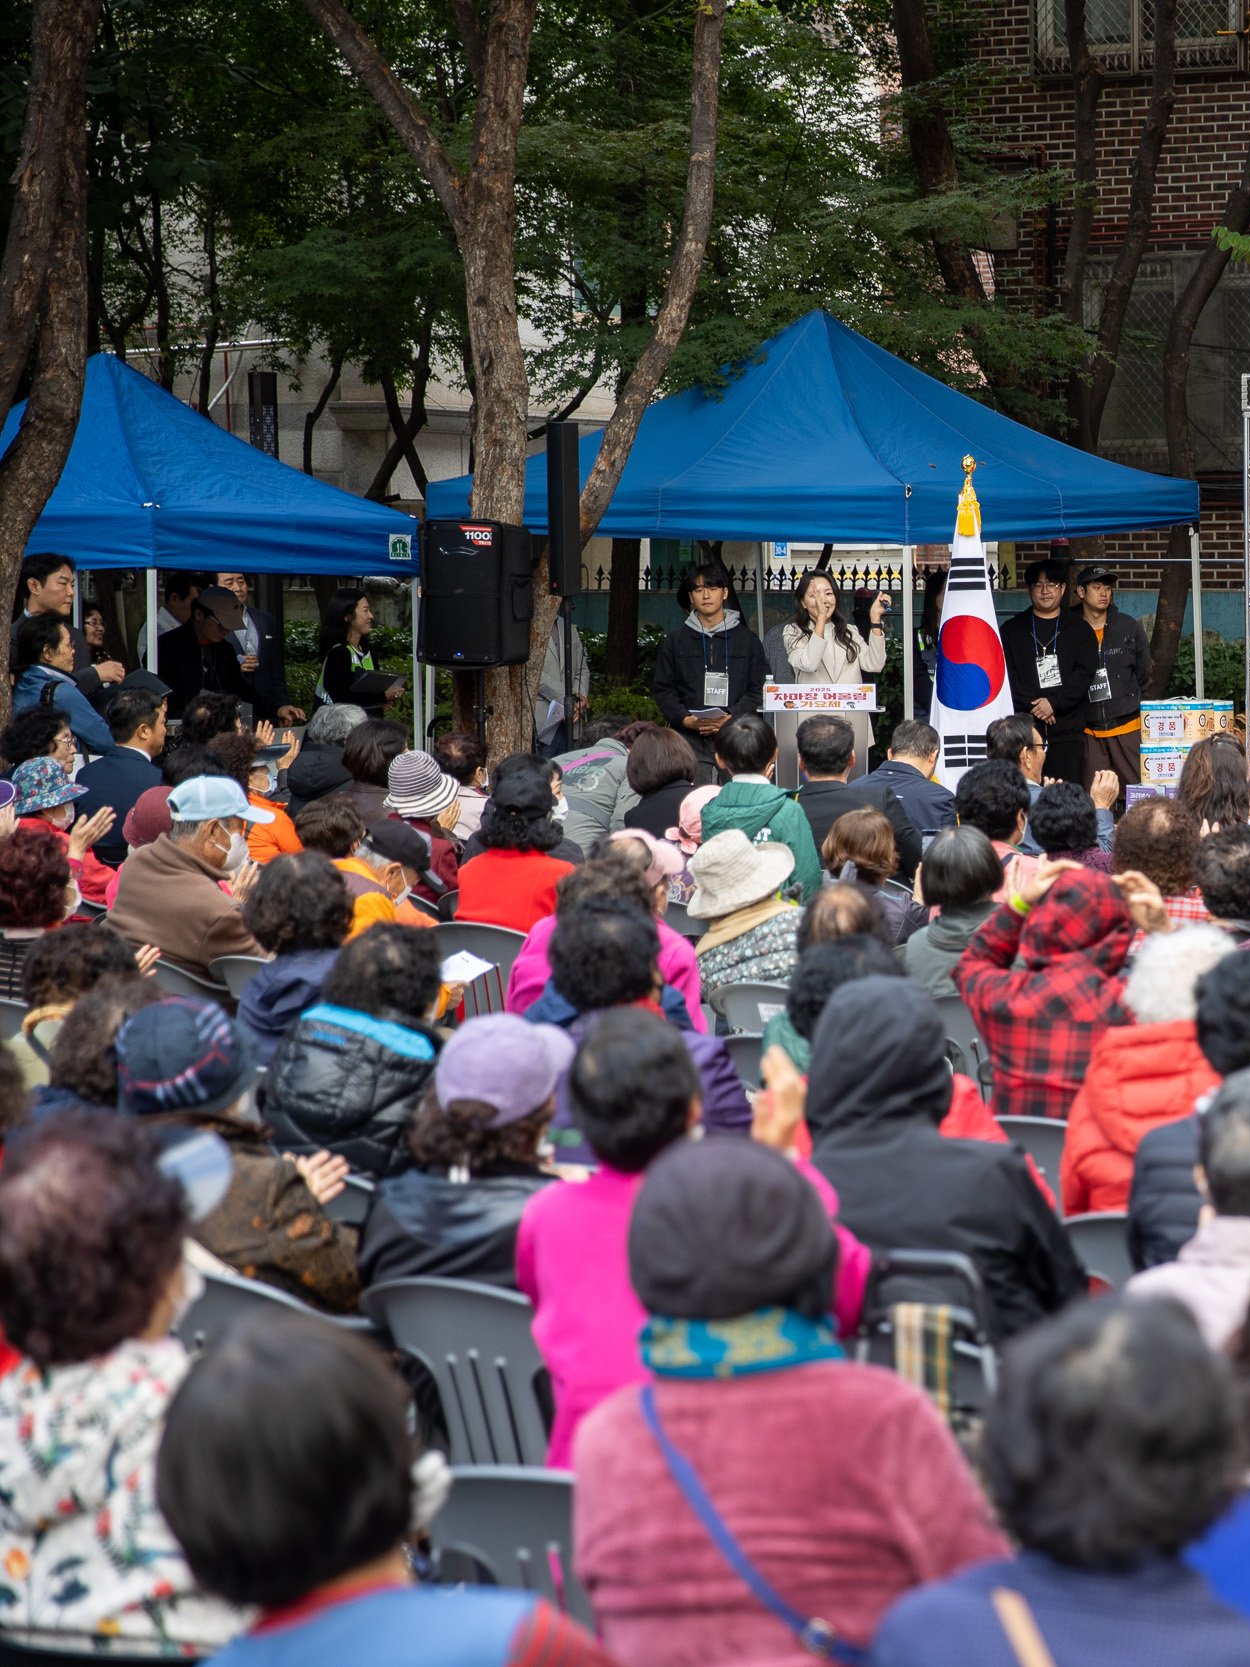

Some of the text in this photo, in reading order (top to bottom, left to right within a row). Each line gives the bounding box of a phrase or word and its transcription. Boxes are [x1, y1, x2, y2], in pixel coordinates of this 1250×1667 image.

[706, 687, 726, 695] STAFF
[773, 693, 867, 701] 자마장 어울림
